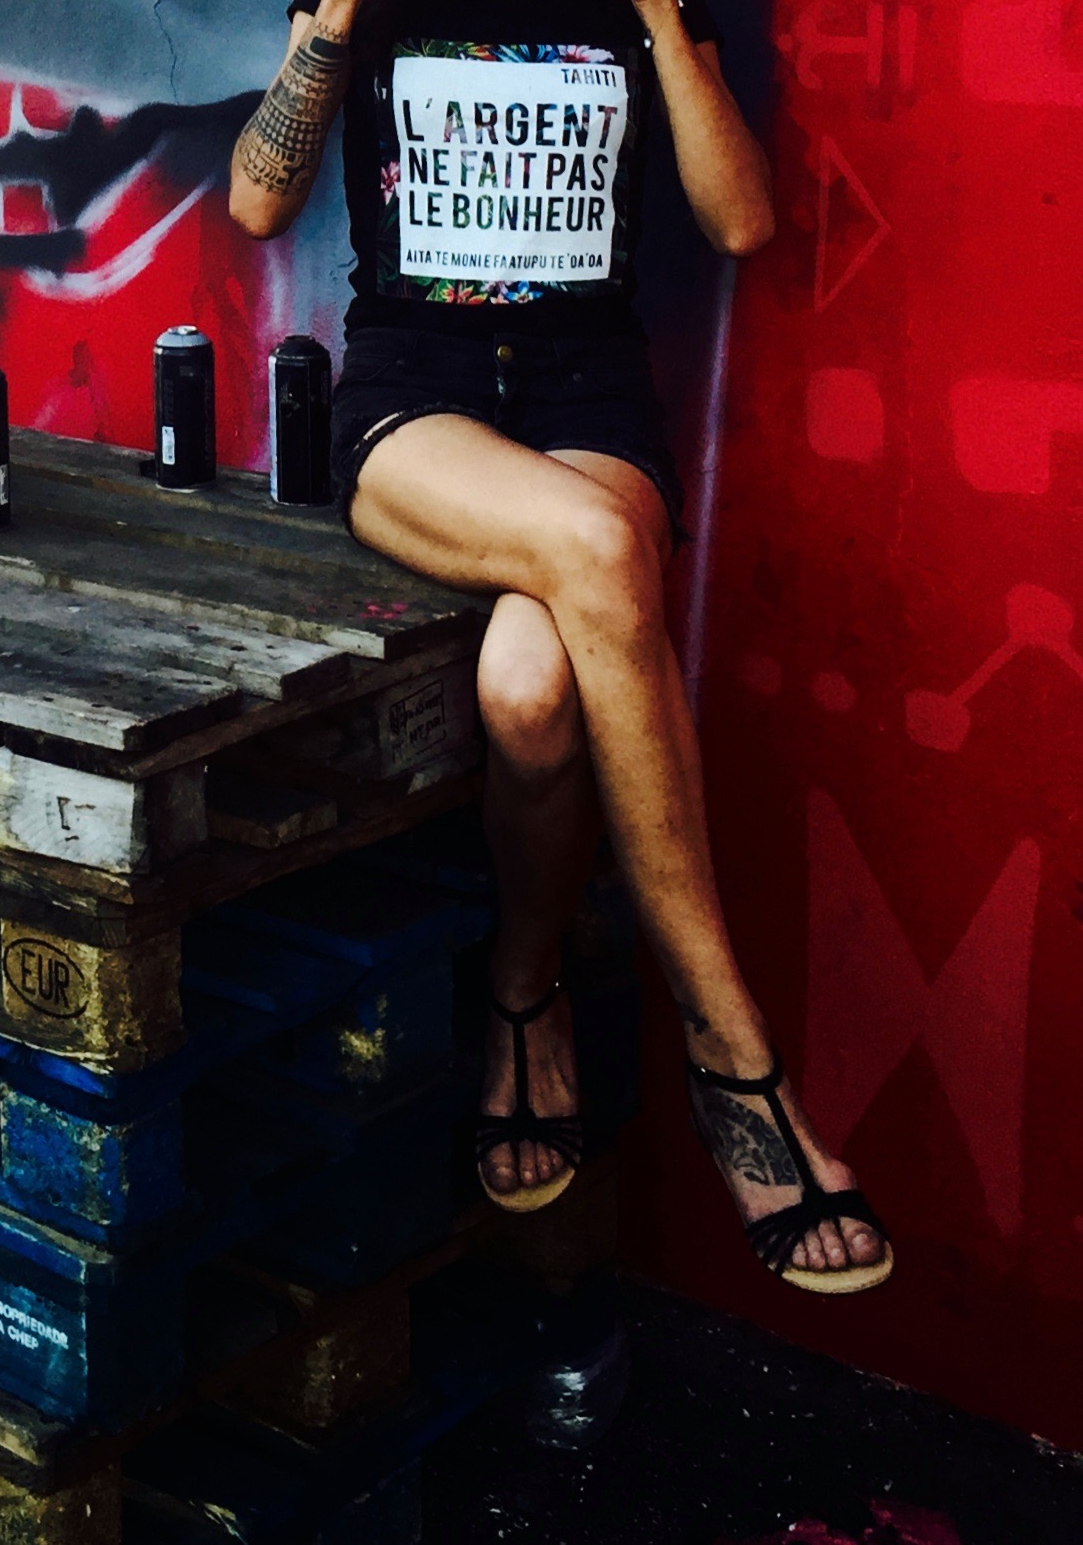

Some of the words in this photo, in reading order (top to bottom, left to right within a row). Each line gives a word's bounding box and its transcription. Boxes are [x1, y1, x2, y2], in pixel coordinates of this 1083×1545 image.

[561, 68, 617, 87] TAHITI
[408, 147, 450, 186] NE
[460, 150, 537, 189] FAIT
[545, 153, 609, 192] PAS
[409, 190, 443, 227] LE
[452, 193, 606, 232] BONHEUR
[406, 249, 432, 264] AITA
[435, 251, 448, 266] TE
[451, 253, 489, 268] MONIE
[550, 255, 564, 269] TE
[20, 947, 70, 1009] EUR
[7, 1325, 39, 1350] CHEP
